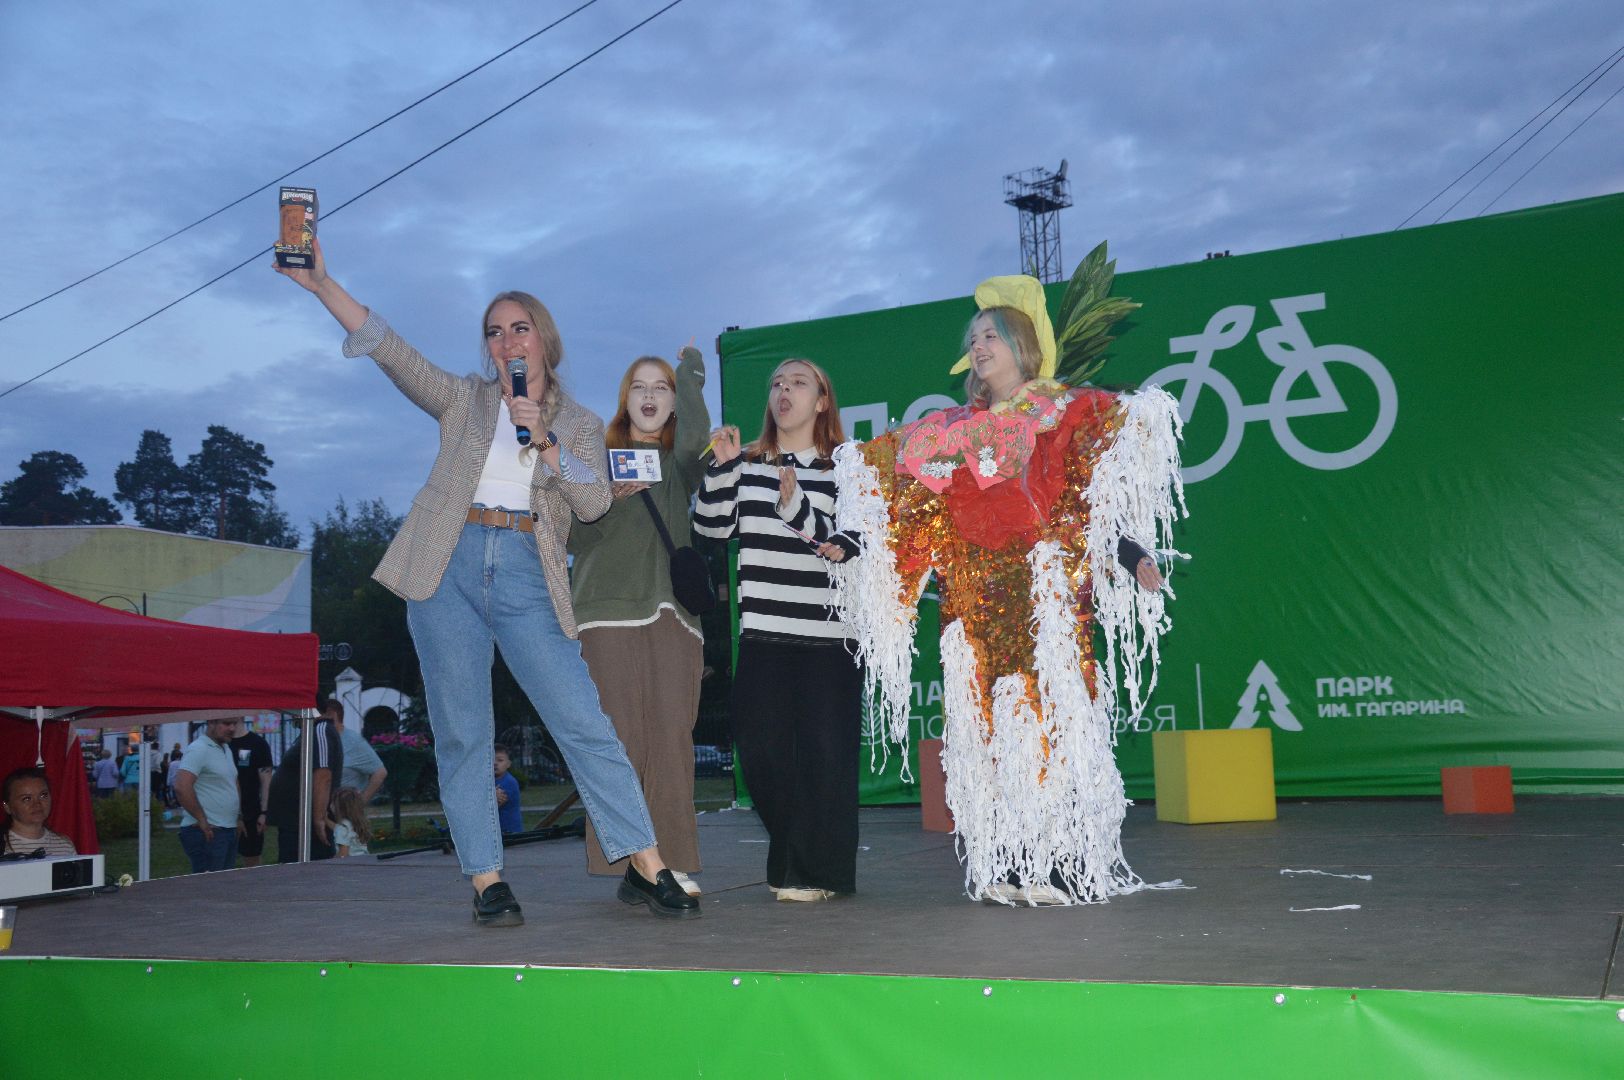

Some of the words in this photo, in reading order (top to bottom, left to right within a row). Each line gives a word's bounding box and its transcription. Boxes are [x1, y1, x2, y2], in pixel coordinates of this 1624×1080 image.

[1316, 675, 1394, 698] ПАРК
[1318, 703, 1351, 718] ИМ.
[1355, 699, 1465, 718] ГАГАРИНА
